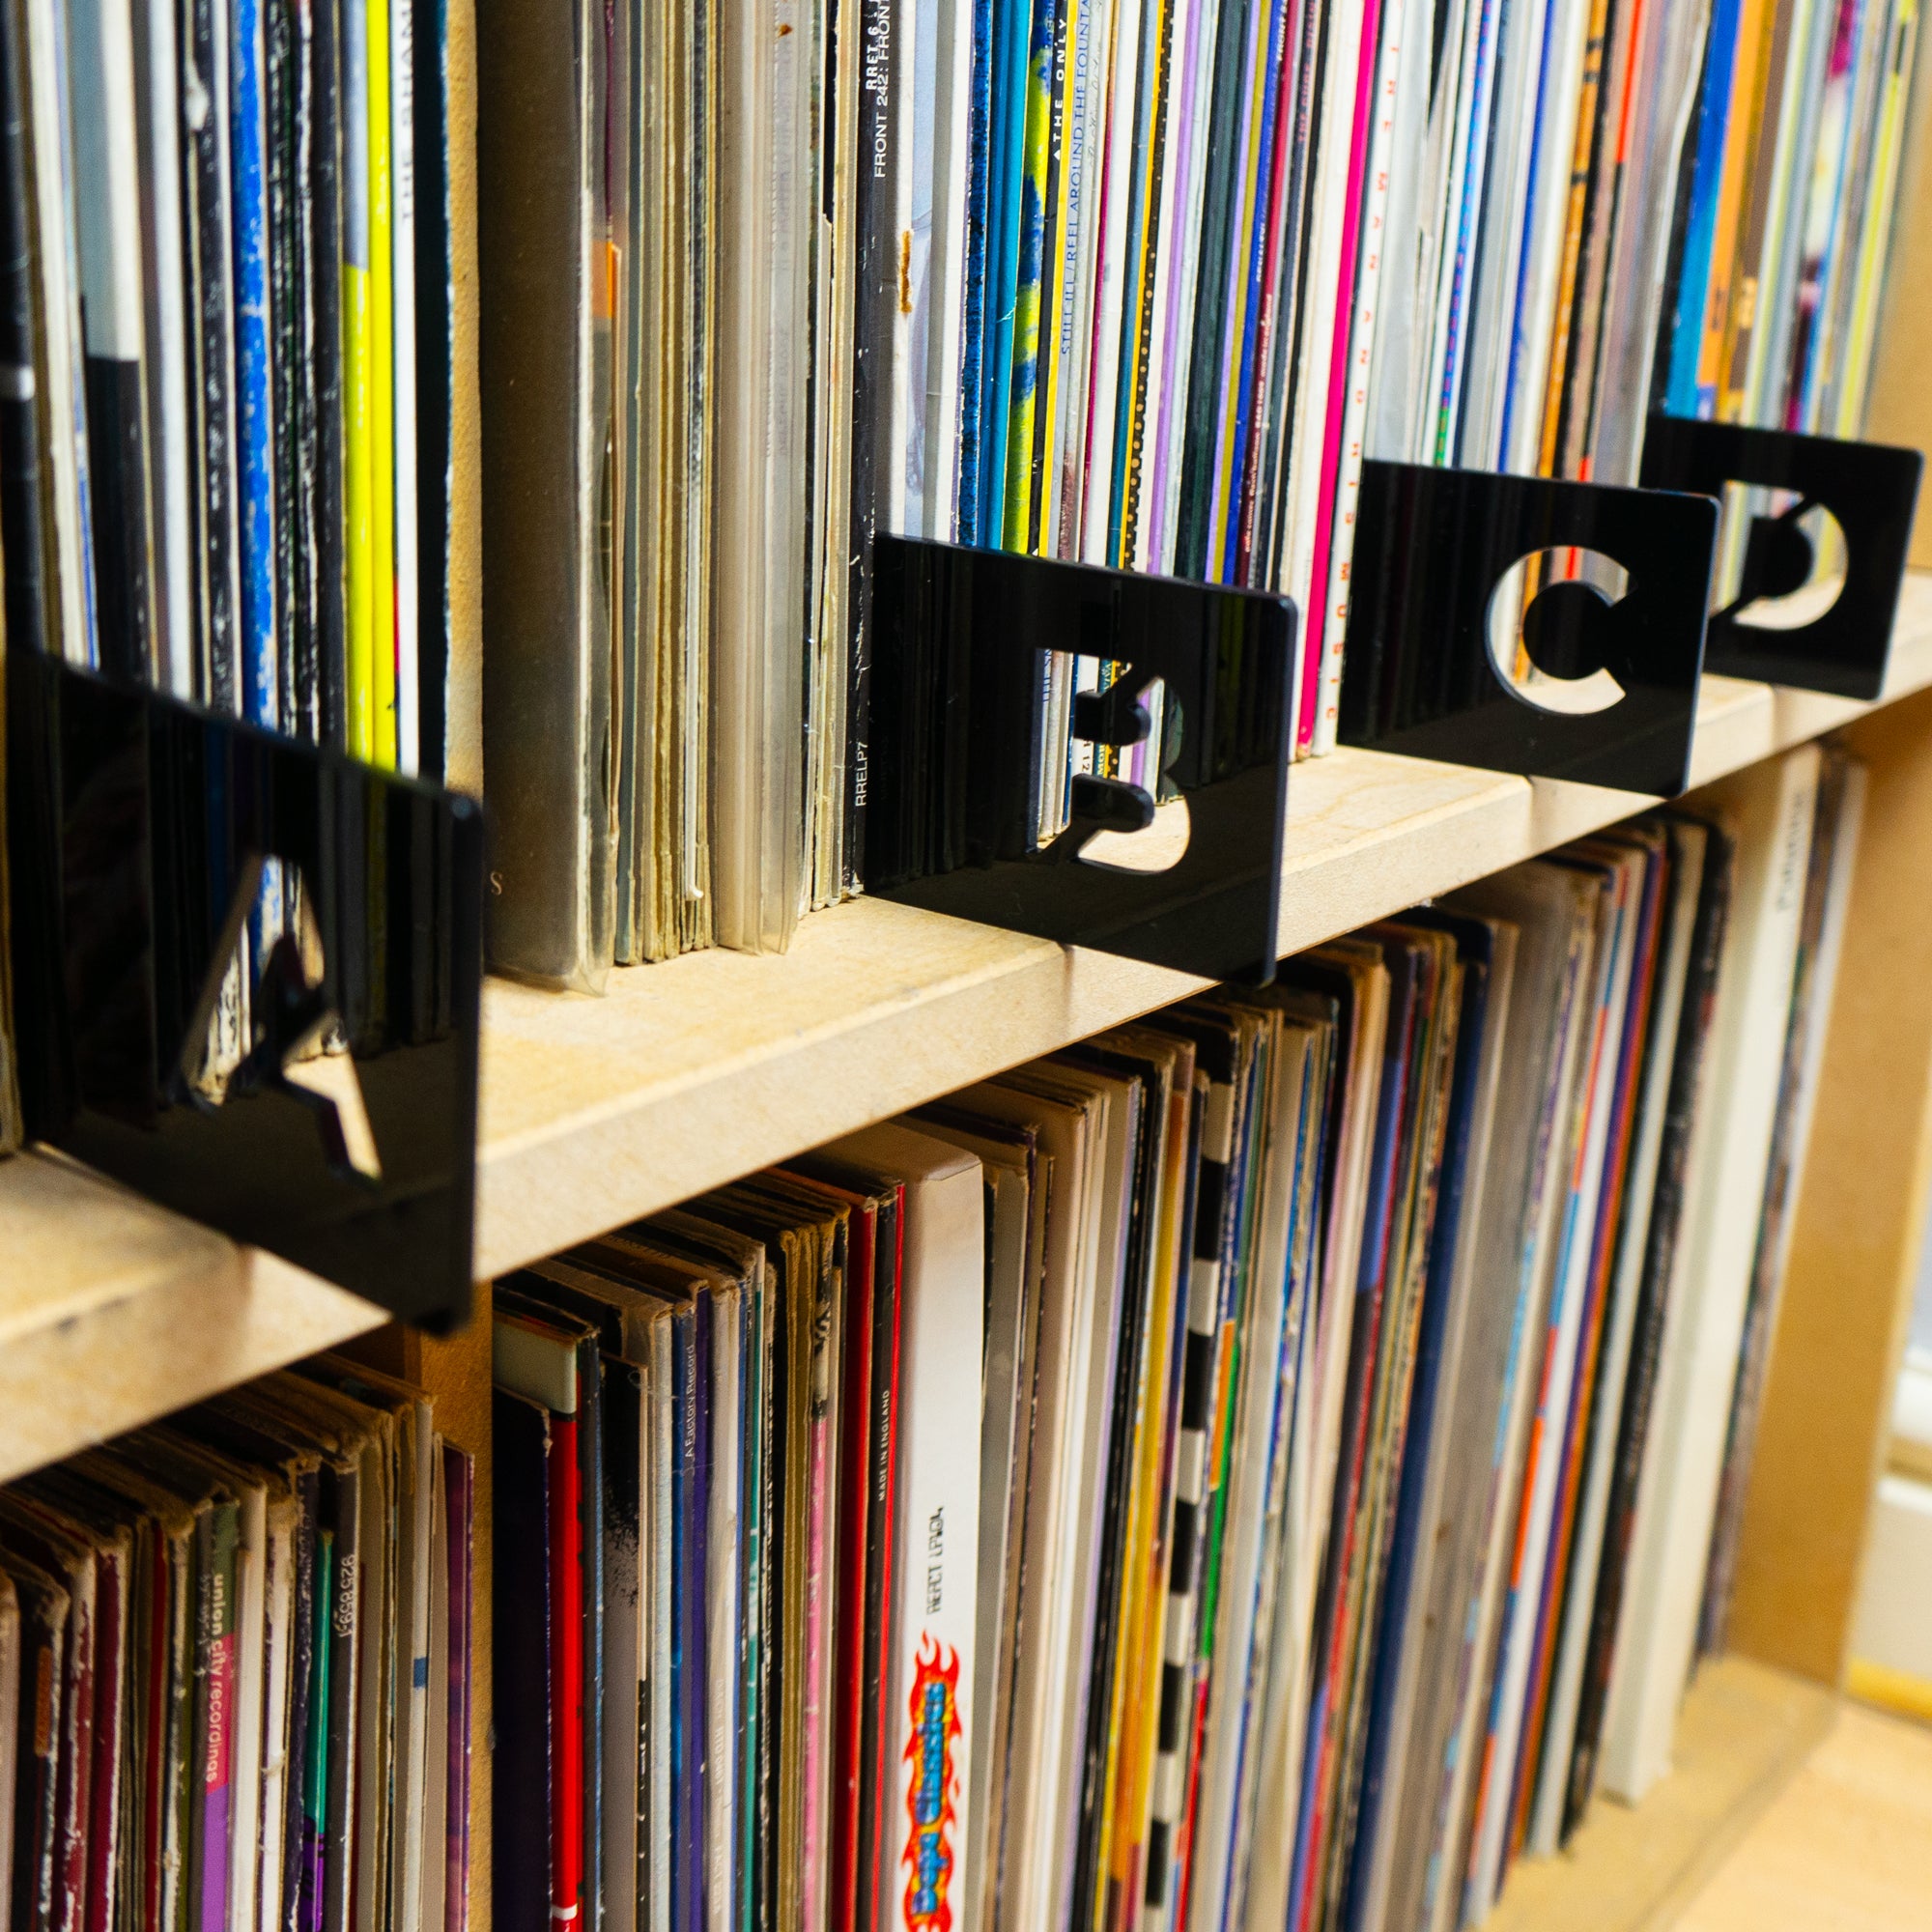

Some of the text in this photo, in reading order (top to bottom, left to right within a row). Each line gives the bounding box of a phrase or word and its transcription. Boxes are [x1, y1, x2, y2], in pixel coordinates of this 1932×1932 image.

[866, 44, 878, 90] RRET
[876, 68, 889, 106] 242:
[1052, 17, 1067, 142] THE ONLY
[1073, 86, 1086, 120] THE
[873, 112, 888, 178] FRONT
[1069, 128, 1084, 211] AROUND
[1065, 213, 1079, 261] REEL
[1060, 305, 1074, 355] STILL
[1487, 545, 1630, 716] C
[855, 741, 868, 807] RRELP7
[1032, 648, 1191, 876] B
[174, 852, 384, 1187] A
[684, 1344, 696, 1458] A Factory Record
[877, 1390, 890, 1501] MADE IN ENGLAND
[211, 1574, 226, 1634] union
[209, 1638, 225, 1676] city
